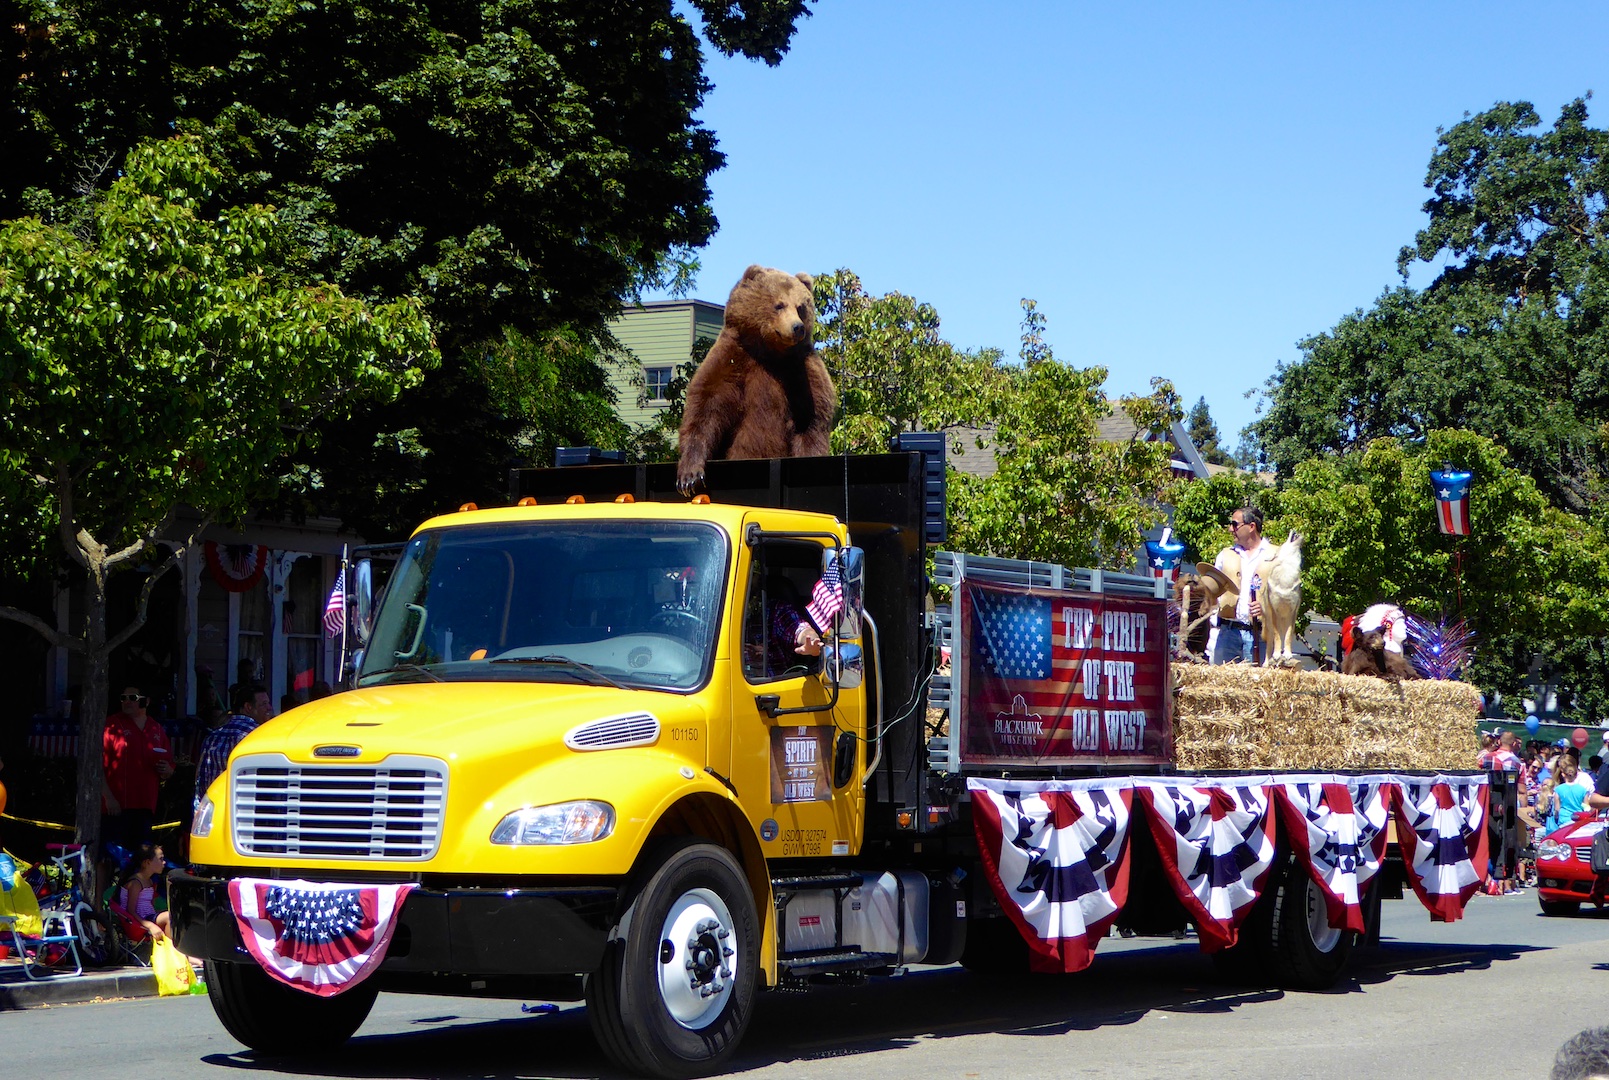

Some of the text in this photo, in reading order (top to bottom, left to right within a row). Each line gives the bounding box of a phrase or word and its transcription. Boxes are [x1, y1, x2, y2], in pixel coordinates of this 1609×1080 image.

[1102, 611, 1148, 652] PIRIT
[1083, 659, 1135, 701] OF THE
[671, 727, 699, 741] 101150
[995, 719, 1043, 735] BLACKHAWK
[1072, 709, 1147, 750] OLD WEST
[1000, 735, 1037, 746] MUSEUMS
[785, 741, 816, 763] SPIRIT
[785, 782, 816, 798] OLD WEST
[781, 829, 805, 842] USDOT
[806, 829, 827, 842] 327574
[783, 843, 800, 855] GVW
